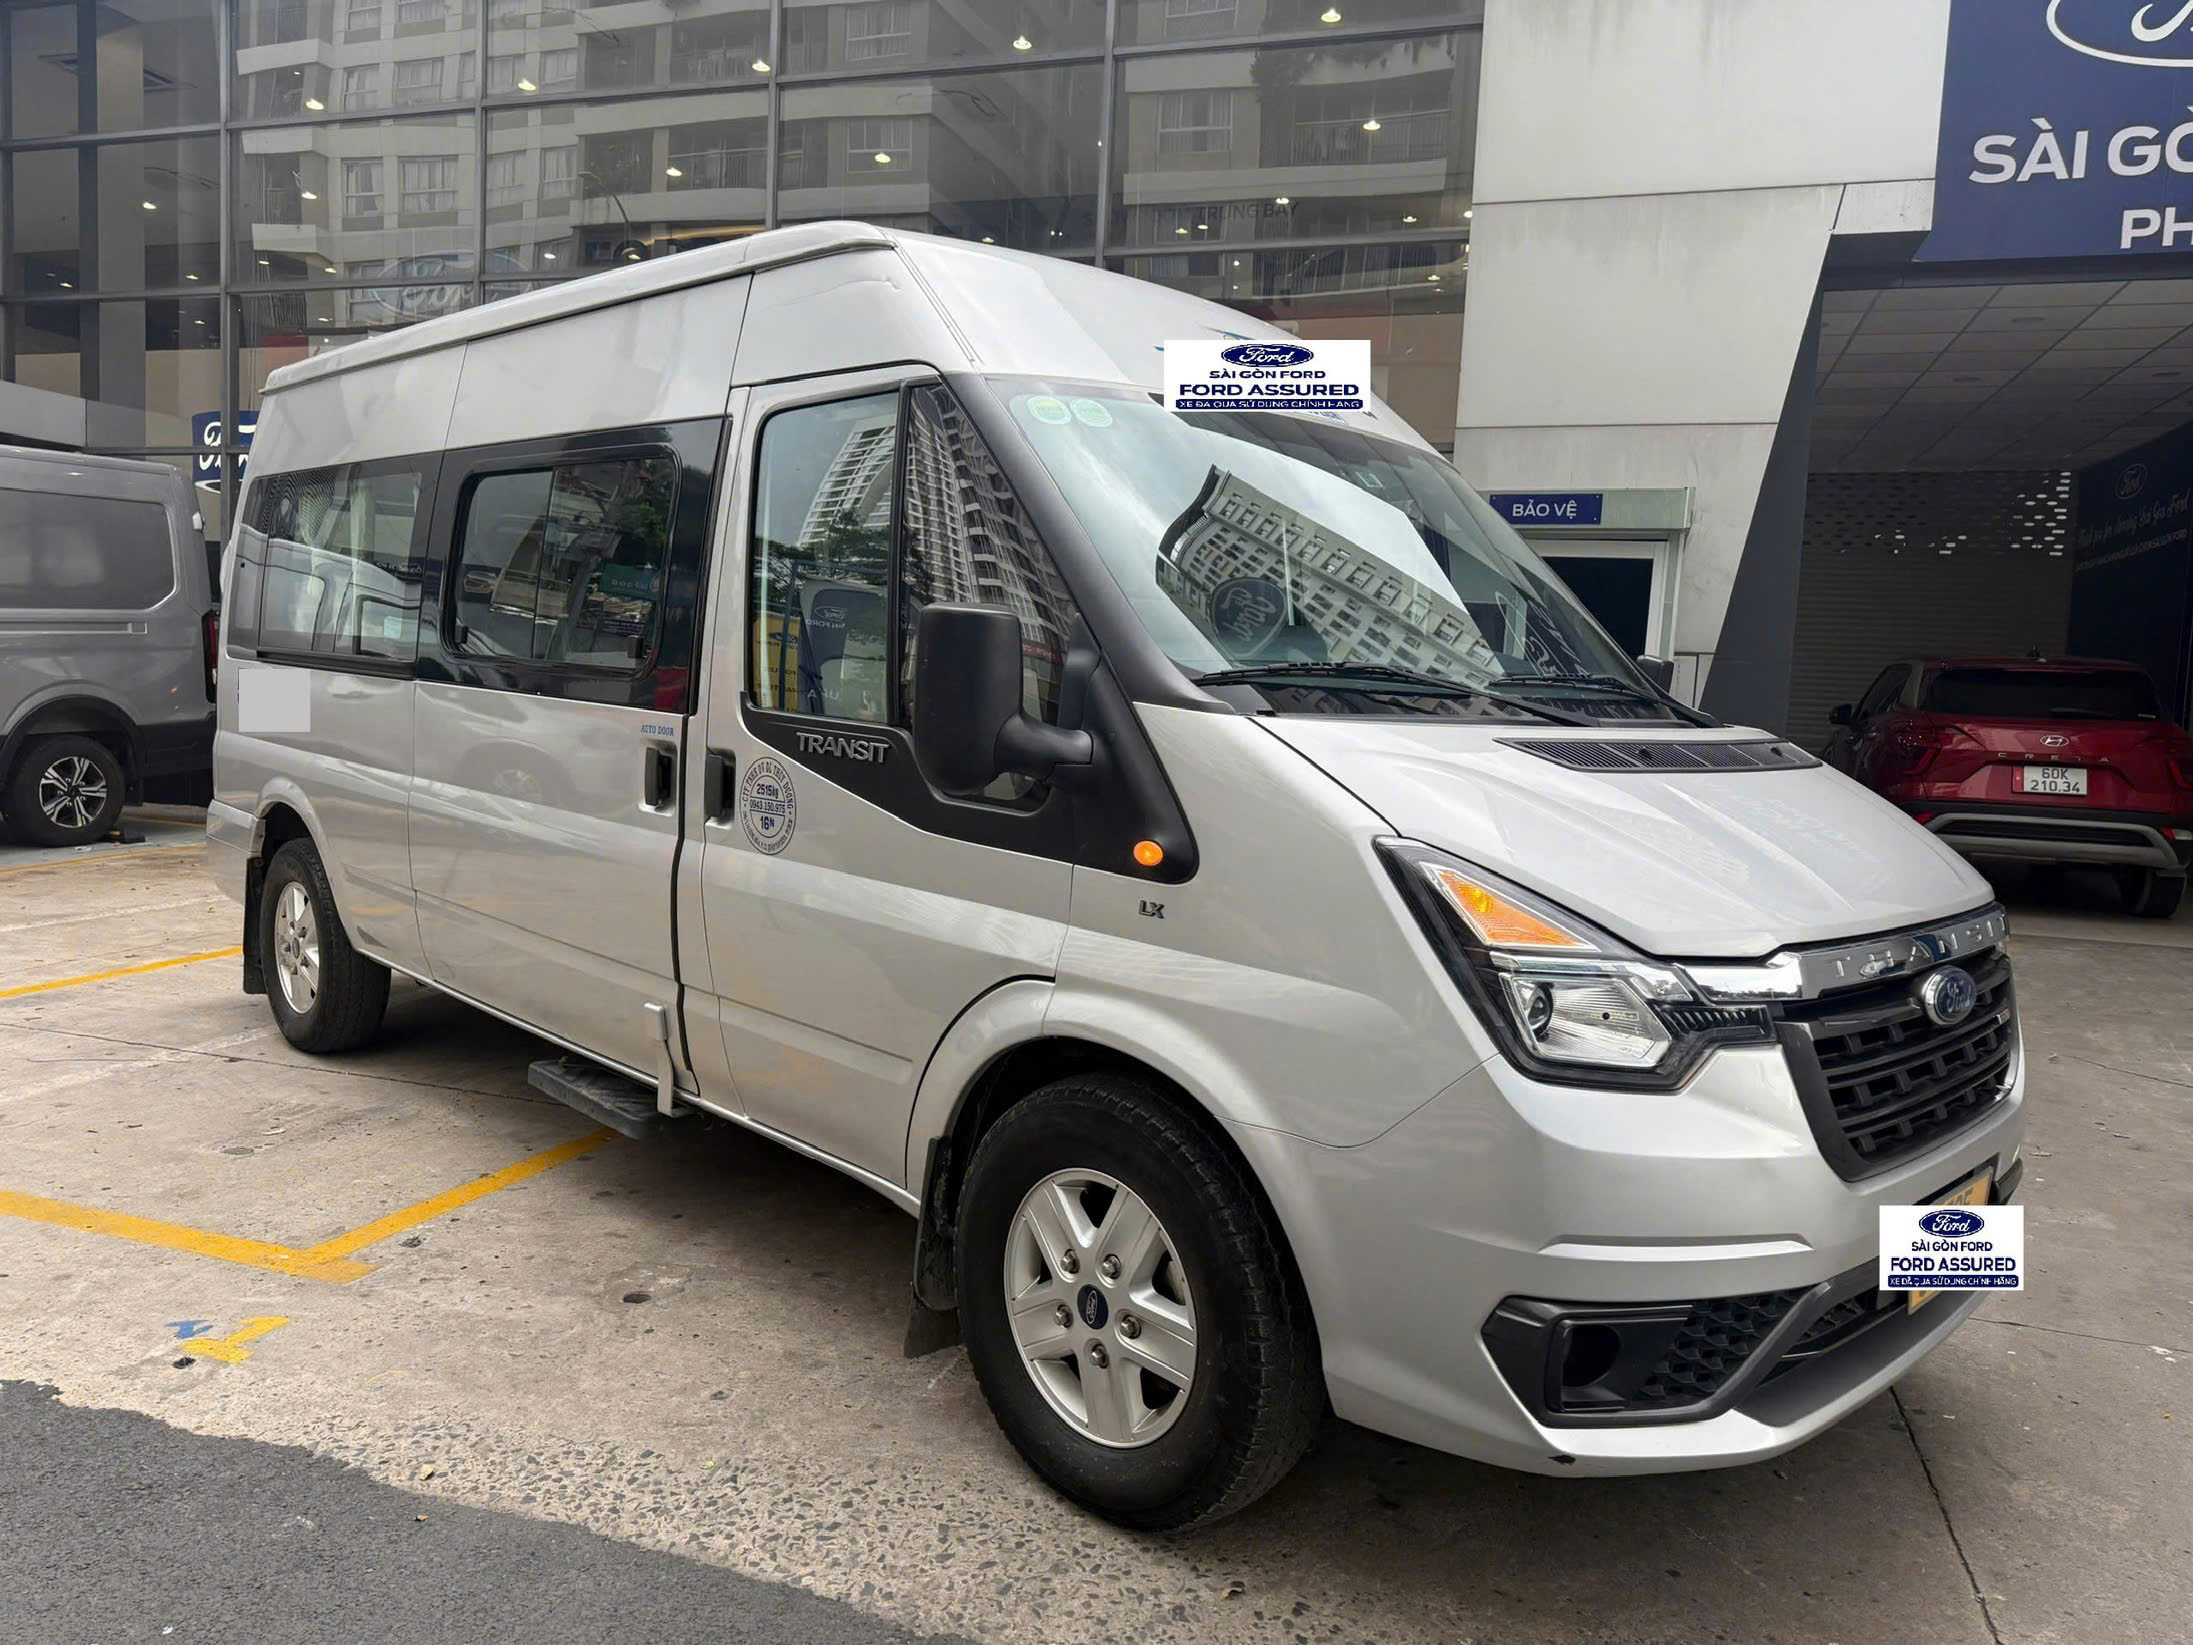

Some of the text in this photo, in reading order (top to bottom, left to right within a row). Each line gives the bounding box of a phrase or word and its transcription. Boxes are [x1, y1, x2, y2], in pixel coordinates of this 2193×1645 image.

[1968, 117, 2089, 184] SÀI
[1512, 499, 1577, 519] BẢO VỆ
[640, 724, 673, 736] AUTO DOOR
[796, 732, 889, 763] TRANSIT
[2041, 767, 2069, 780] 60K
[2030, 780, 2081, 793] 210.34
[1139, 900, 1165, 919] LX
